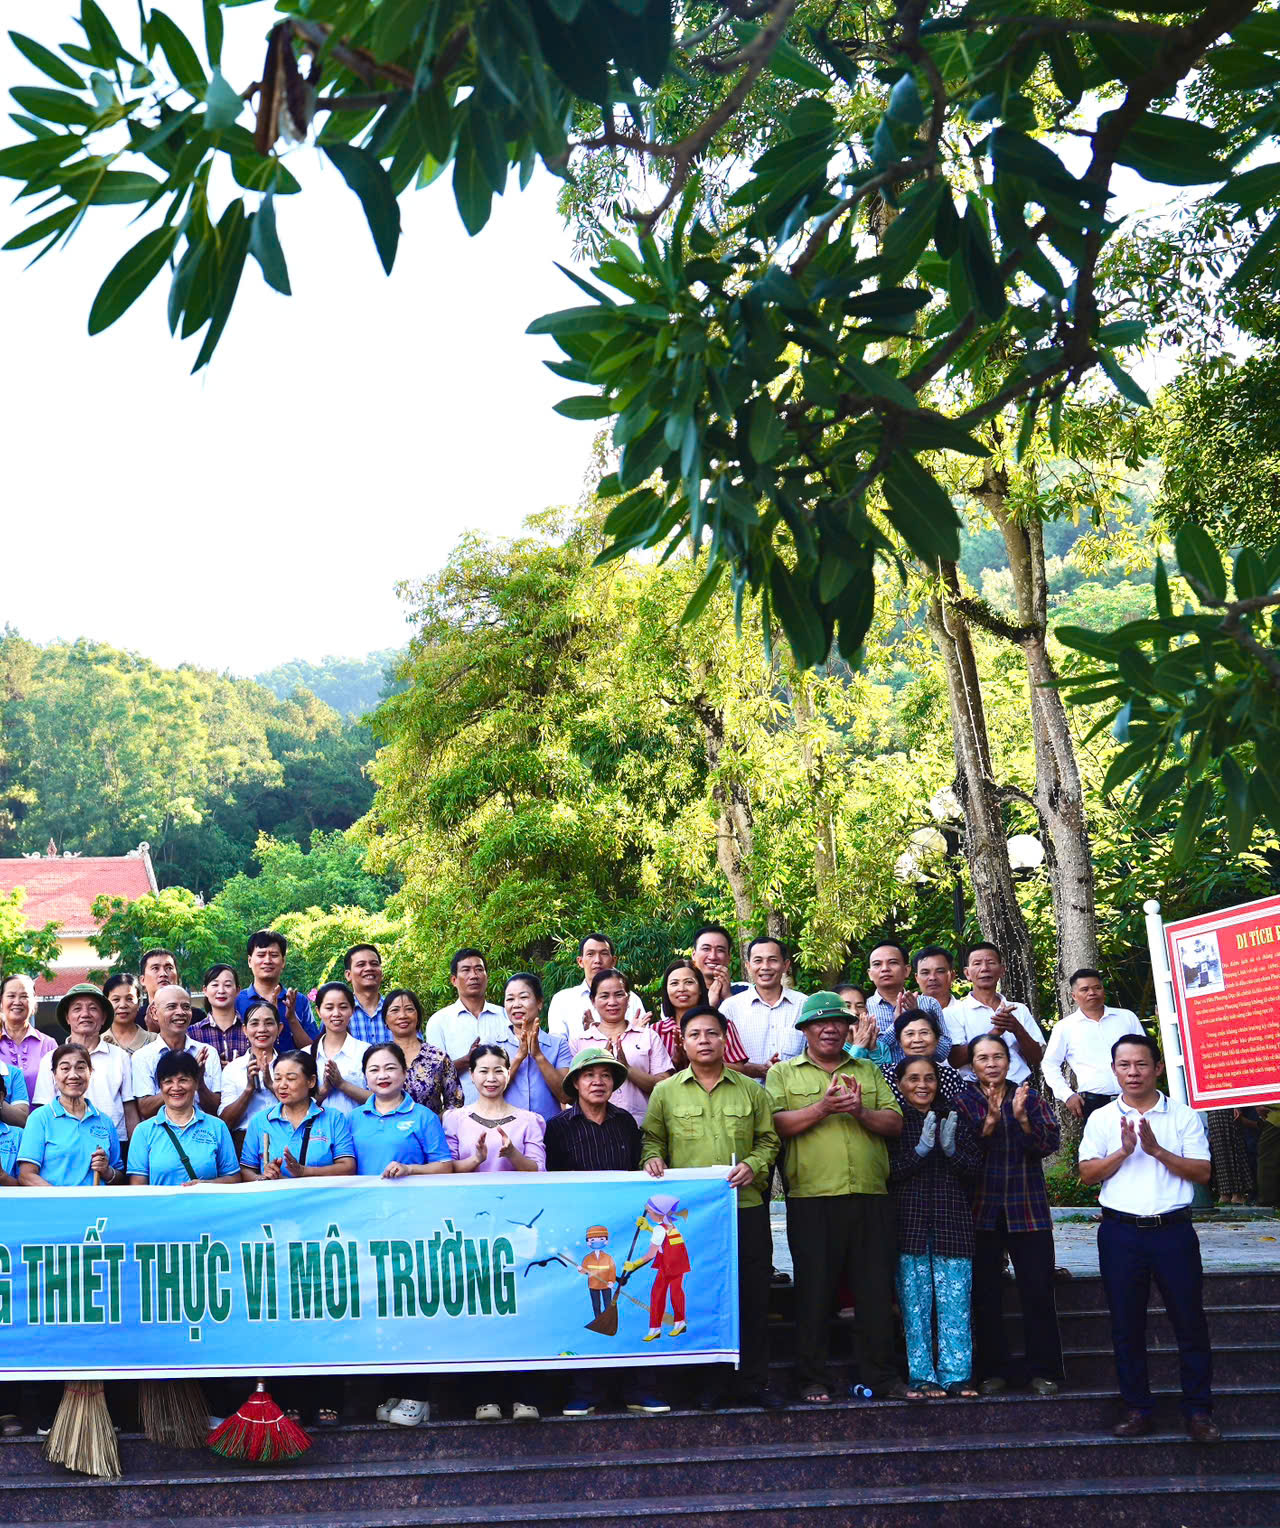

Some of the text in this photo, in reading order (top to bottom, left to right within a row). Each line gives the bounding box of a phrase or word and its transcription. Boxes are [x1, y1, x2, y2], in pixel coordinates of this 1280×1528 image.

[1235, 933, 1249, 950] DI
[1248, 926, 1275, 946] TÍCH
[21, 1217, 126, 1325] THIẾT
[134, 1233, 232, 1342] THỰC
[239, 1223, 279, 1322] VÌ
[288, 1223, 362, 1322] MÔI
[368, 1217, 518, 1320] TRƯỜNG
